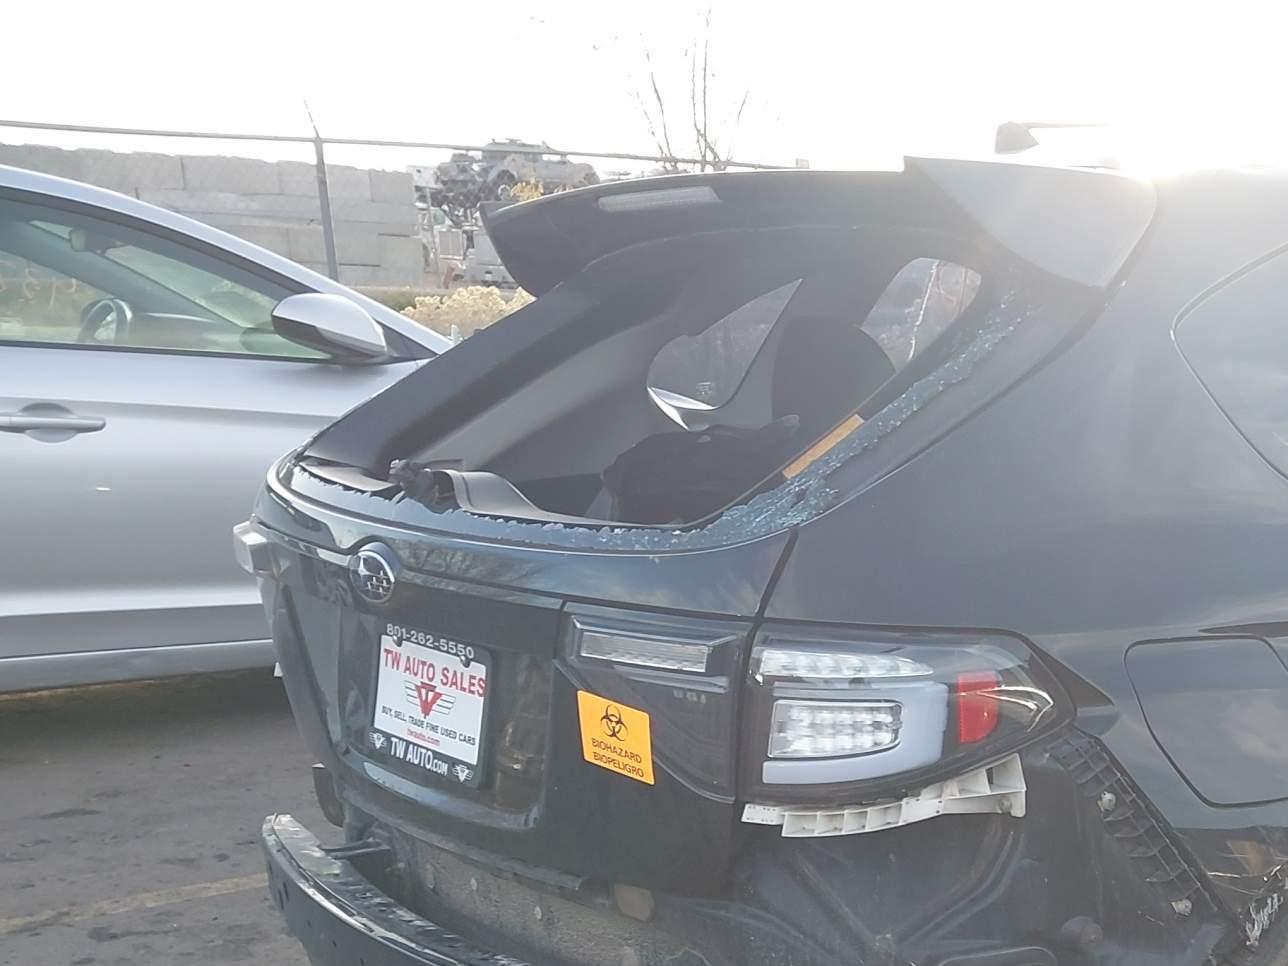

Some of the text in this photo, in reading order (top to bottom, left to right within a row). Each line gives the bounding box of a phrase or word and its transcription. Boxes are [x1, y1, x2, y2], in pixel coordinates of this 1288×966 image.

[386, 623, 475, 658] 801-262-5550
[384, 648, 486, 698] TW AUTO SALES
[408, 715, 425, 729] TRADE
[426, 721, 439, 735] FINE
[440, 727, 457, 740] USED
[458, 733, 477, 746] CARS
[390, 737, 406, 759] TW
[591, 737, 642, 763] BIOHAZARD
[592, 751, 645, 778] BIOPELIGRO
